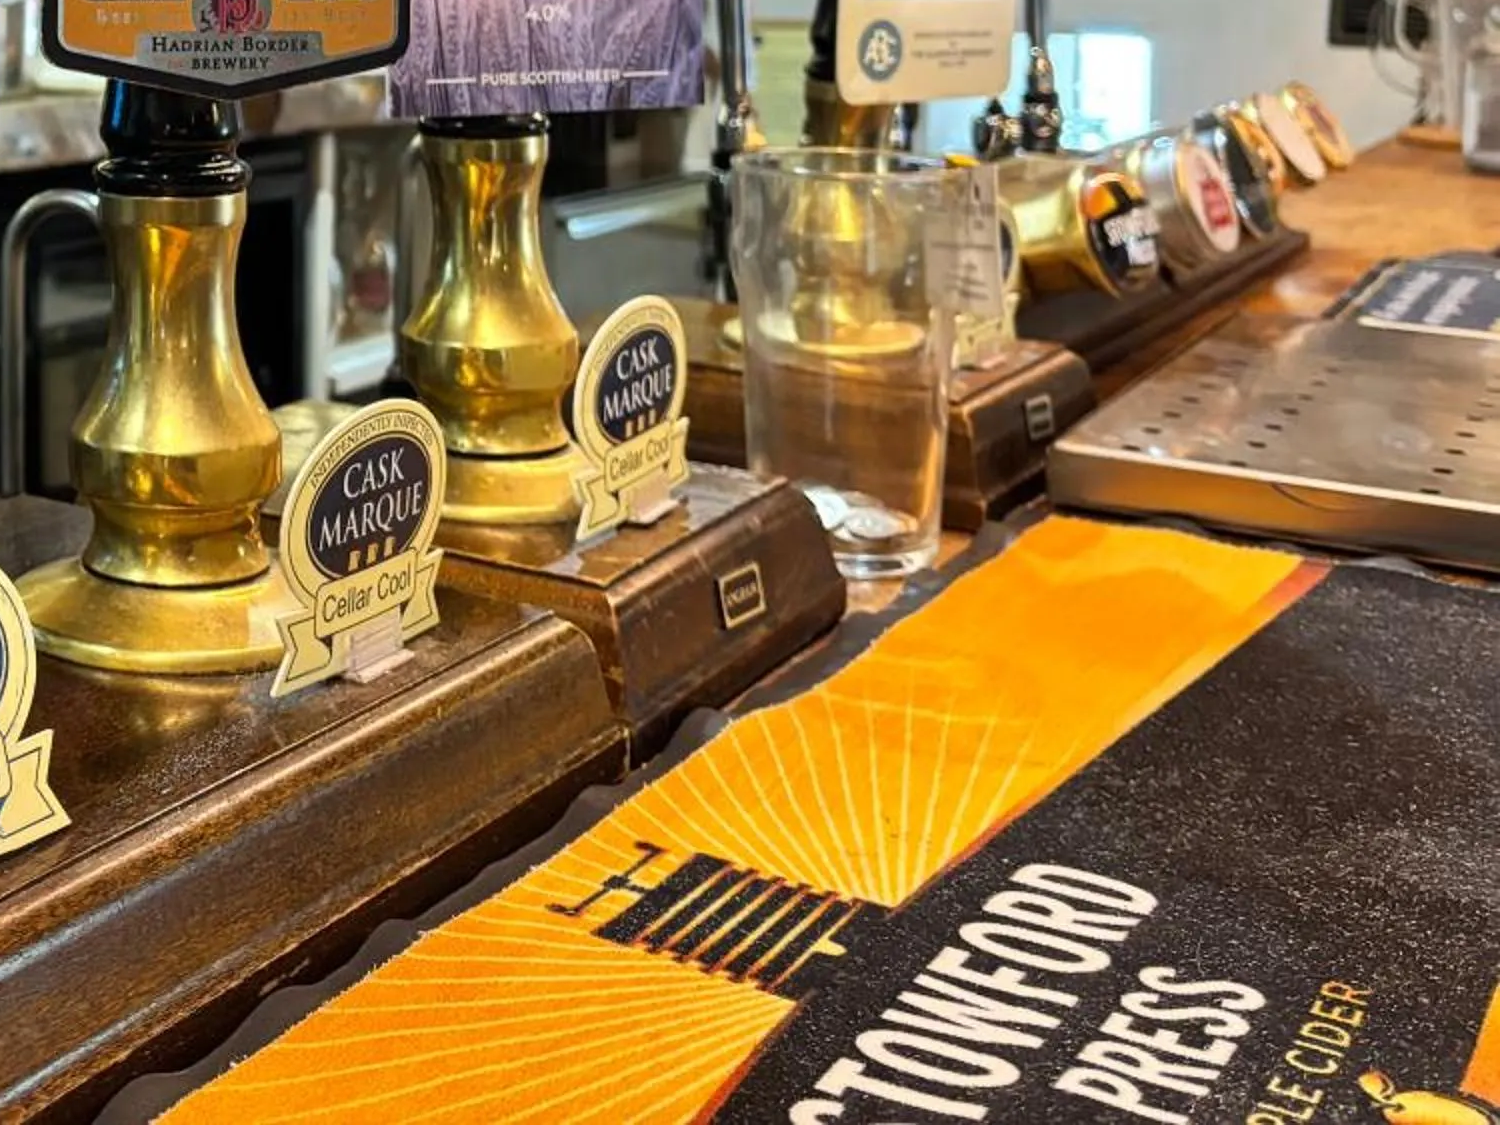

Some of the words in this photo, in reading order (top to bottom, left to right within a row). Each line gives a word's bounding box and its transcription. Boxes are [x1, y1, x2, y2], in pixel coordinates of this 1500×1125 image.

[525, 4, 571, 23] 4.0%
[191, 56, 269, 71] BREWERY
[481, 72, 517, 87] PURE
[616, 336, 661, 380] CASK
[603, 363, 672, 424] MARQUE
[343, 447, 405, 498] CASK
[610, 448, 643, 479] Cellar
[646, 435, 670, 460] Cool
[318, 481, 423, 552] MARQUE
[322, 585, 372, 623] Cellar
[377, 563, 411, 600] Cool
[1053, 966, 1267, 1125] PRESS
[1286, 980, 1376, 1074] CIDER
